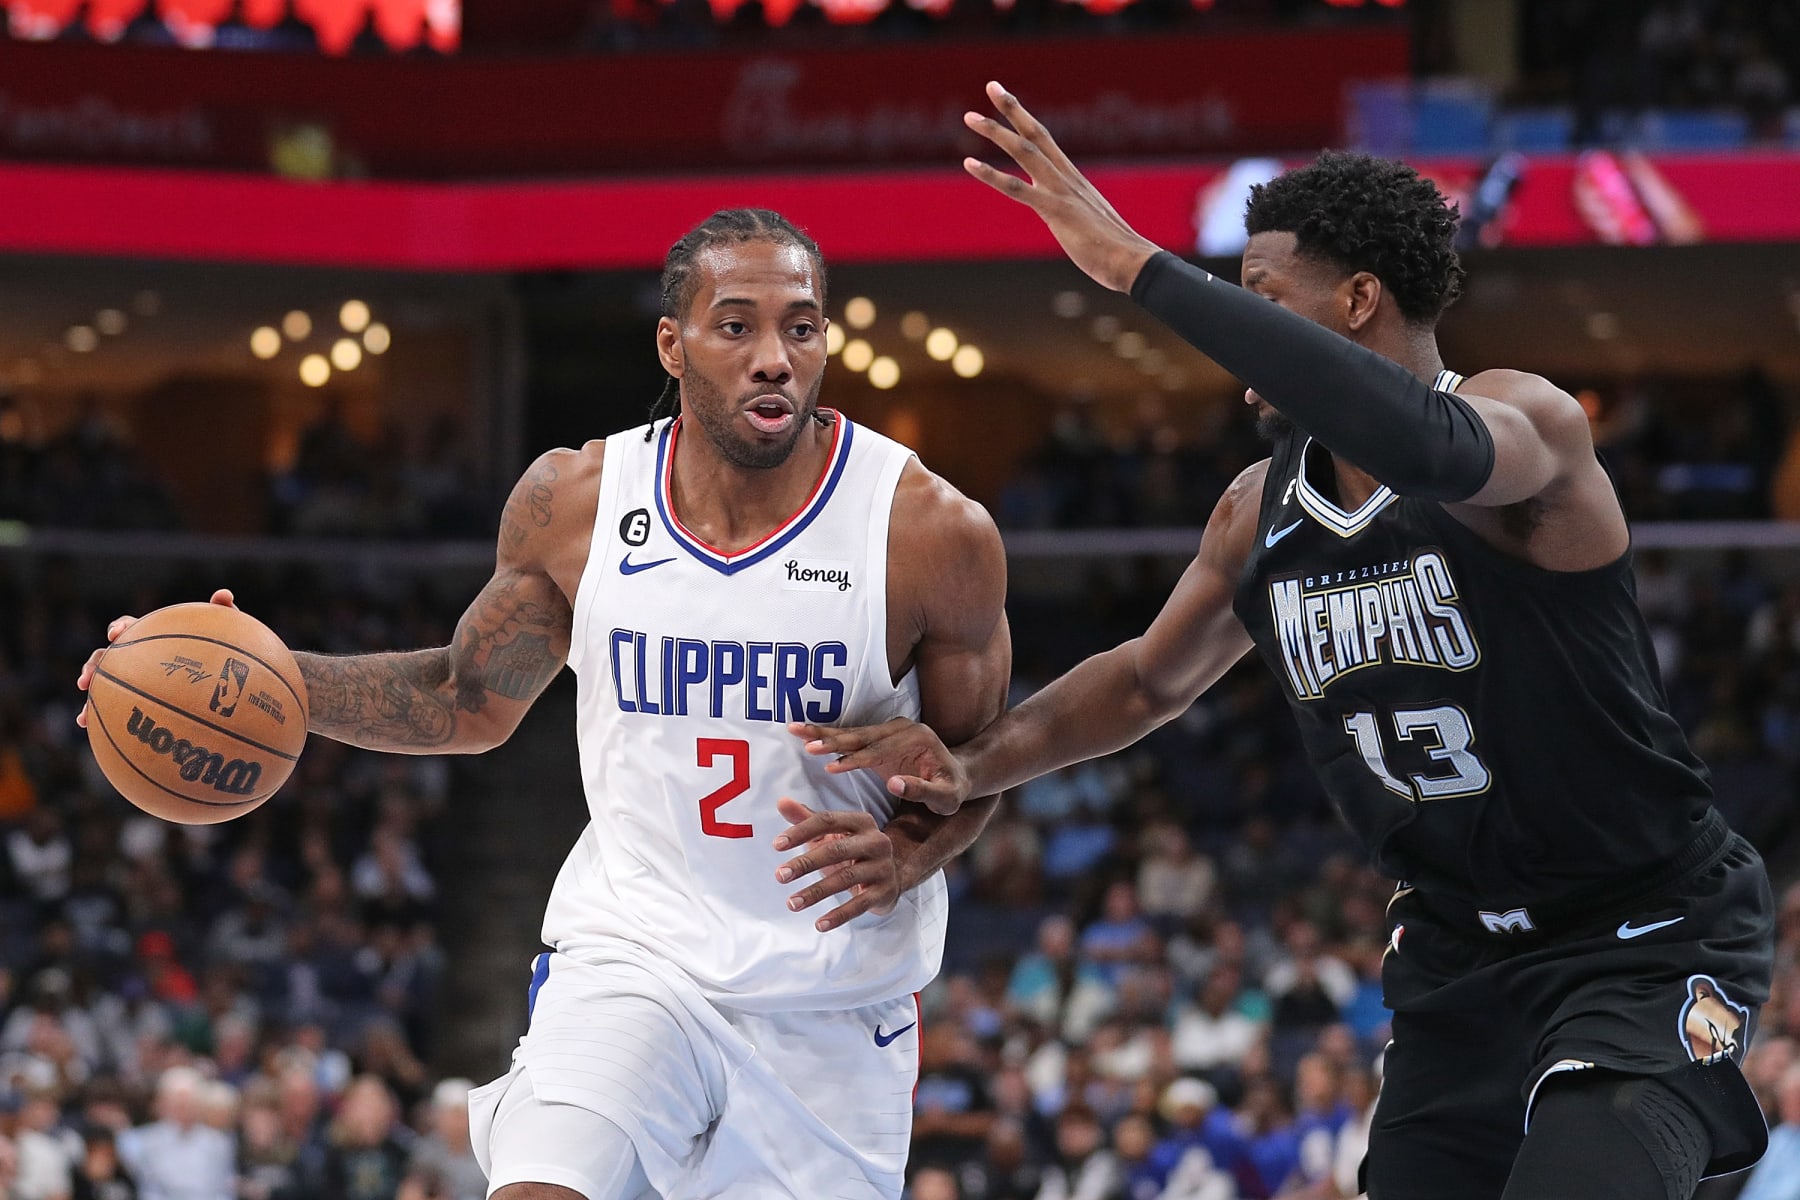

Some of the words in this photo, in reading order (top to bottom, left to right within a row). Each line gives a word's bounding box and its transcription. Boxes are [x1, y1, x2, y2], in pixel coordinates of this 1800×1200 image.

[627, 511, 648, 543] 6
[784, 560, 852, 592] honey
[1305, 560, 1409, 588] GRIZZLIES
[1269, 551, 1481, 700] MEMPHIS
[609, 627, 848, 723] CLIPPERS
[126, 706, 262, 796] Wilson
[696, 737, 753, 839] 2
[1342, 704, 1493, 802] 13
